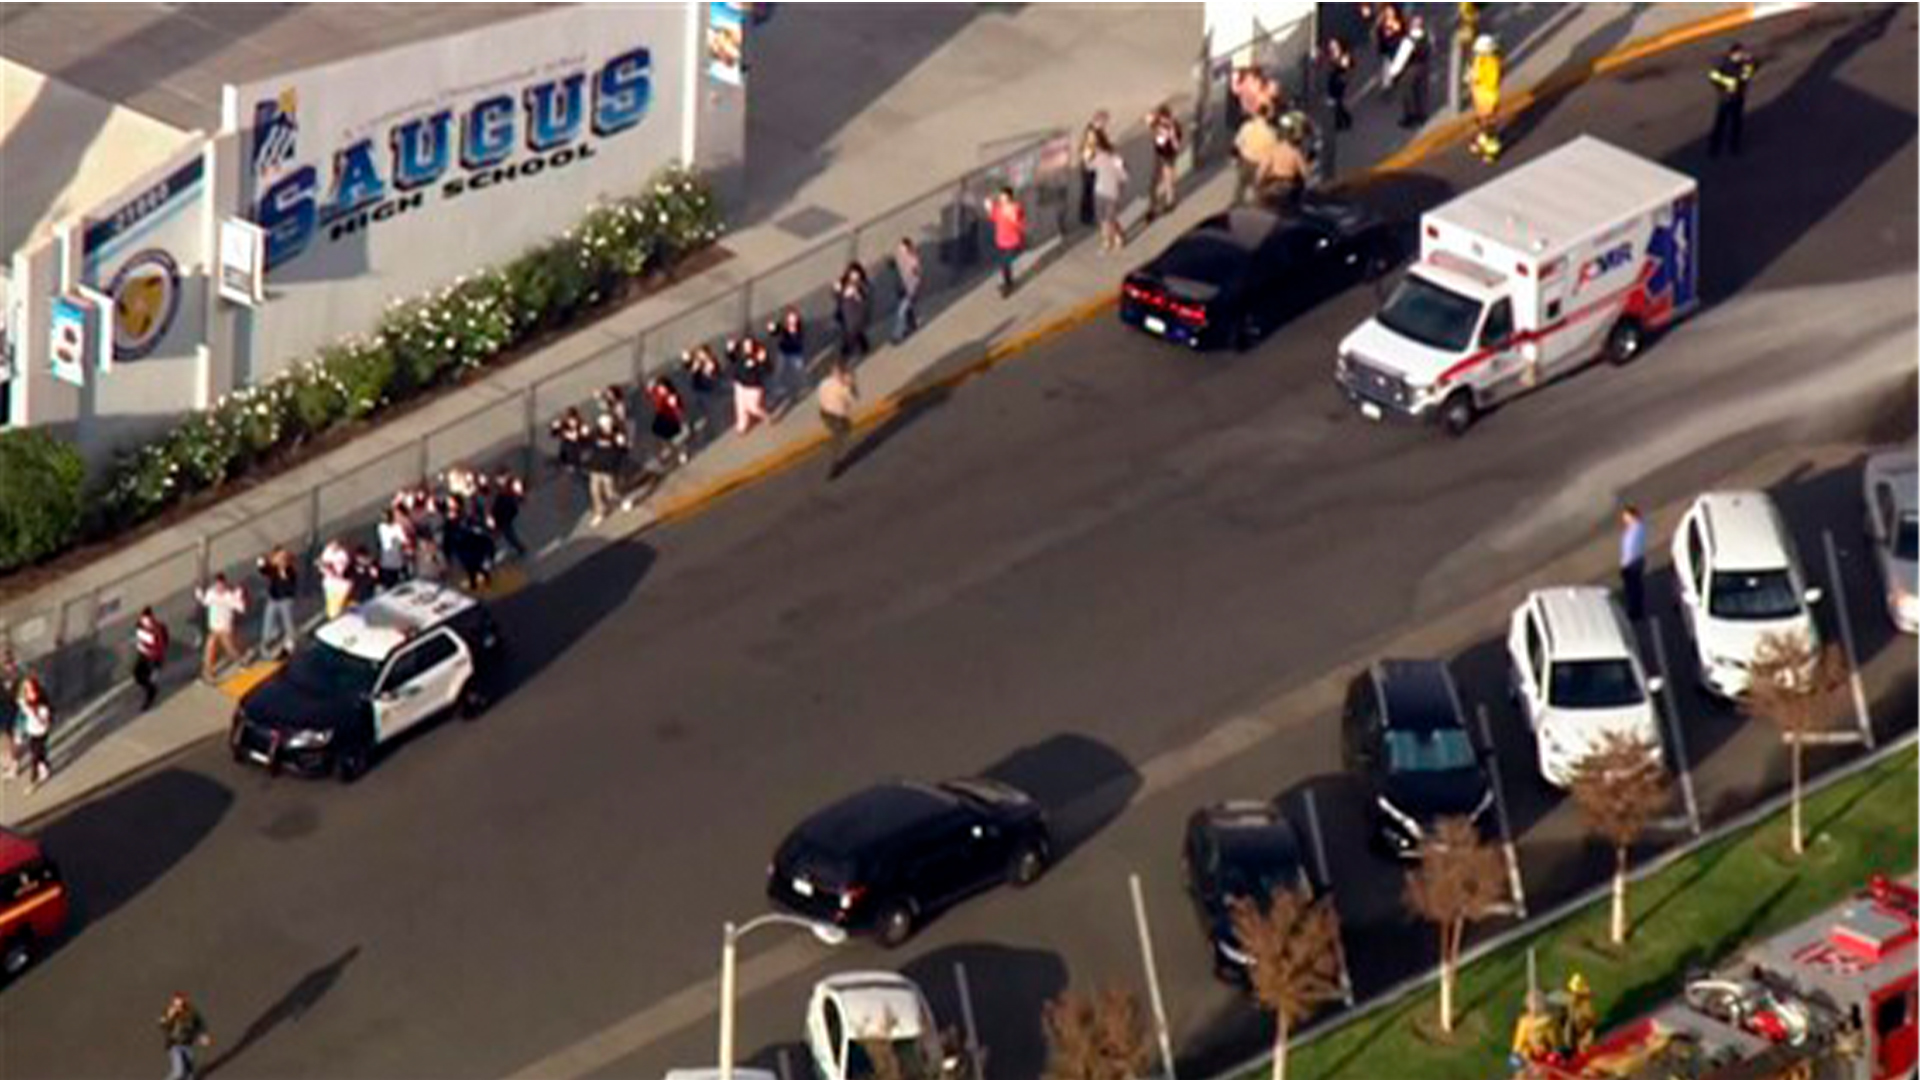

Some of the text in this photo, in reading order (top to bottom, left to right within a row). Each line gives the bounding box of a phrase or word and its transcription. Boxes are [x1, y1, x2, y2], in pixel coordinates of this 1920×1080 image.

[257, 46, 655, 273] SAUGUS
[329, 143, 597, 241] HIGH SCHOOL
